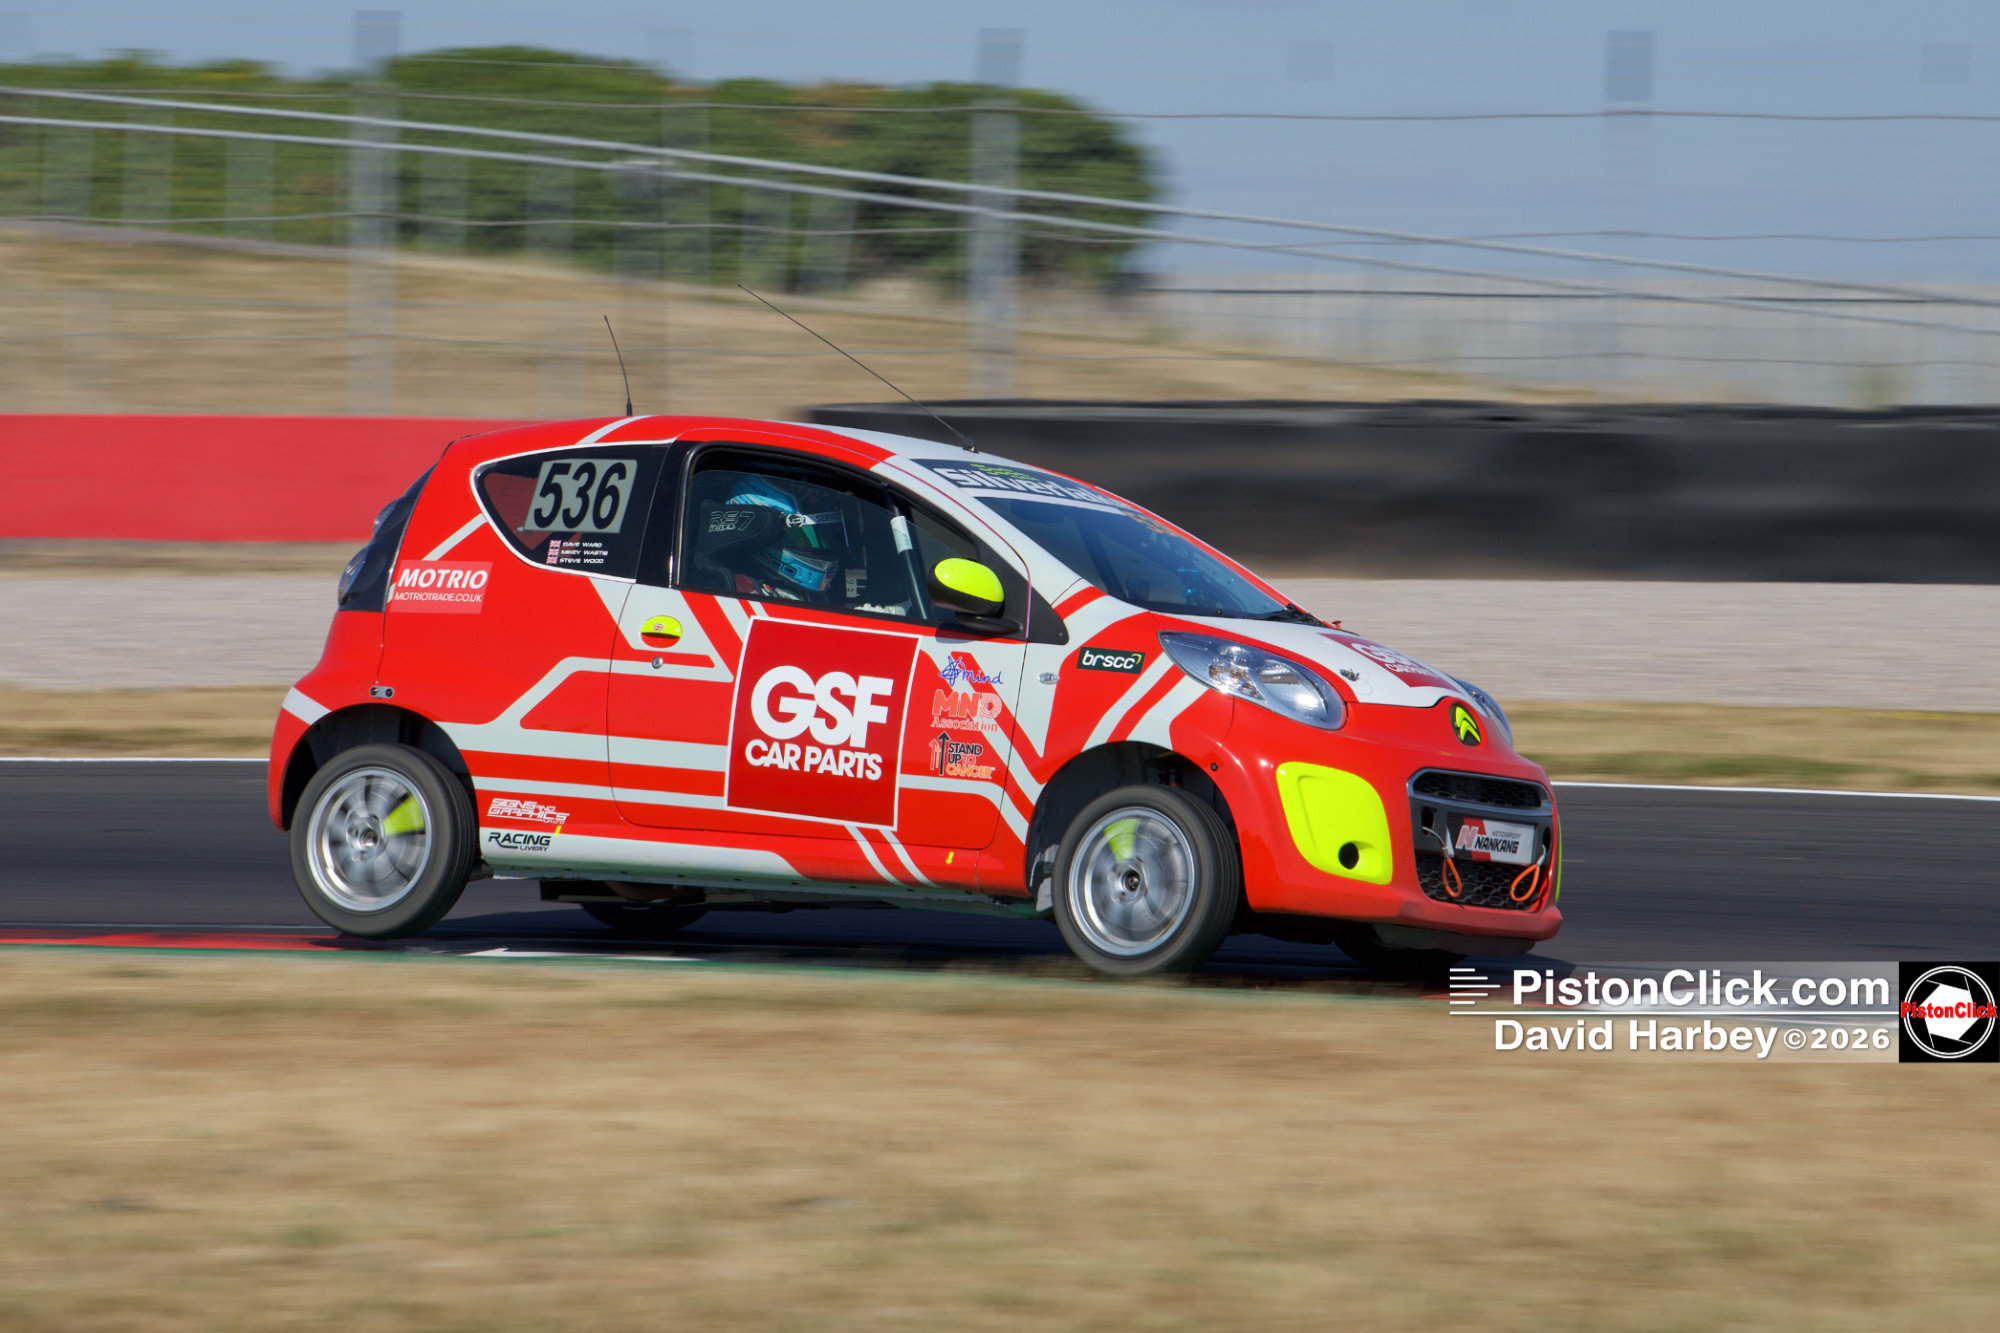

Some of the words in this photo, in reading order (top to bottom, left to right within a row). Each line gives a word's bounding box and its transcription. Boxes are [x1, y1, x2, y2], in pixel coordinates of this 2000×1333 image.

[534, 462, 626, 529] 536
[710, 511, 756, 531] RS7
[397, 568, 488, 590] MOTRIO
[394, 592, 483, 603] MOTRIOTRADE.CO.UK
[1082, 650, 1136, 670] brscc
[962, 669, 1004, 685] mind
[751, 665, 894, 749] GSF
[932, 689, 1003, 721] MND
[931, 716, 999, 732] Association
[948, 742, 983, 756] STAND
[745, 739, 801, 771] CAR
[803, 745, 883, 781] PARTS
[947, 753, 961, 764] UP
[961, 755, 976, 765] TO
[946, 763, 993, 779] CANCER
[491, 798, 537, 809] SIGNS
[486, 806, 570, 821] GRAPHICS
[488, 832, 551, 849] RACING
[1475, 836, 1520, 854] NANKANG
